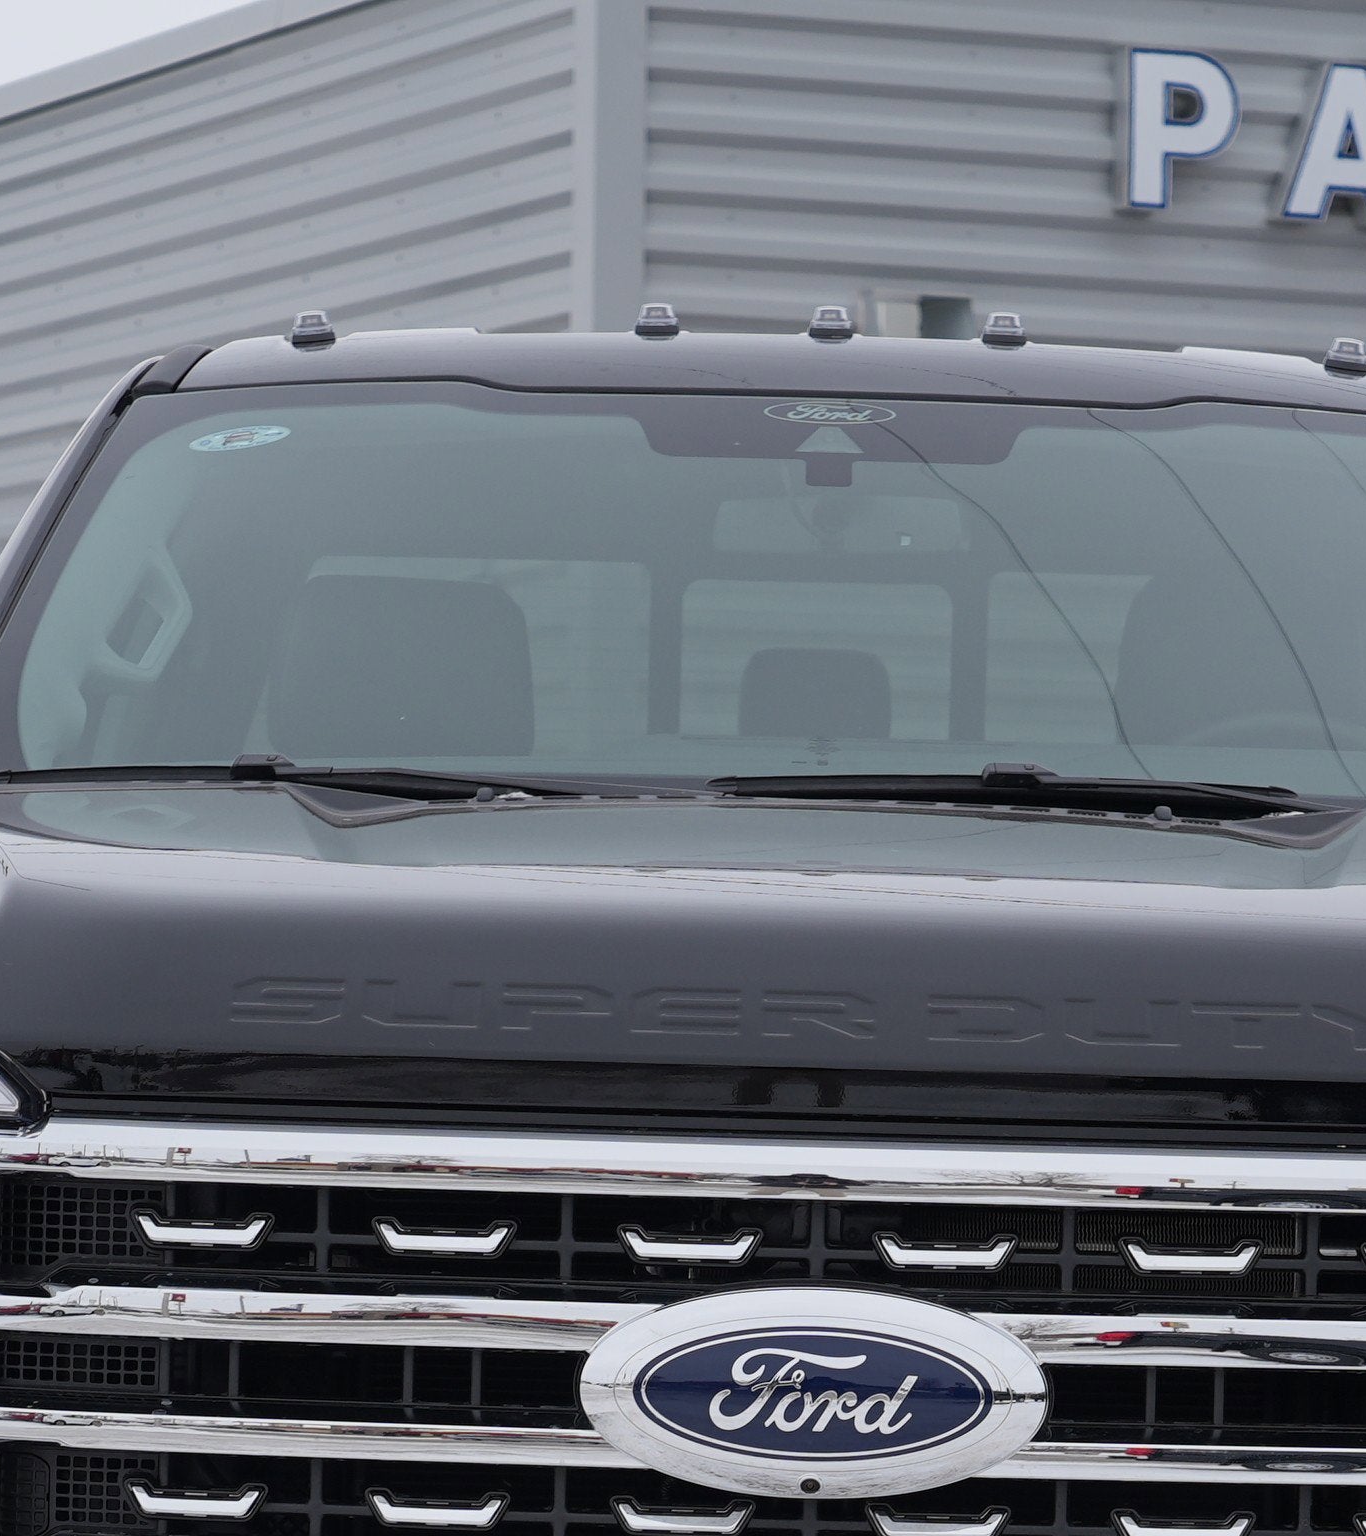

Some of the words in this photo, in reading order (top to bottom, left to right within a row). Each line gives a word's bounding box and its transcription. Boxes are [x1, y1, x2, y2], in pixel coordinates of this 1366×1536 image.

[787, 403, 873, 422] Ford
[229, 976, 876, 1041] SUPER
[708, 1347, 919, 1435] Ford
